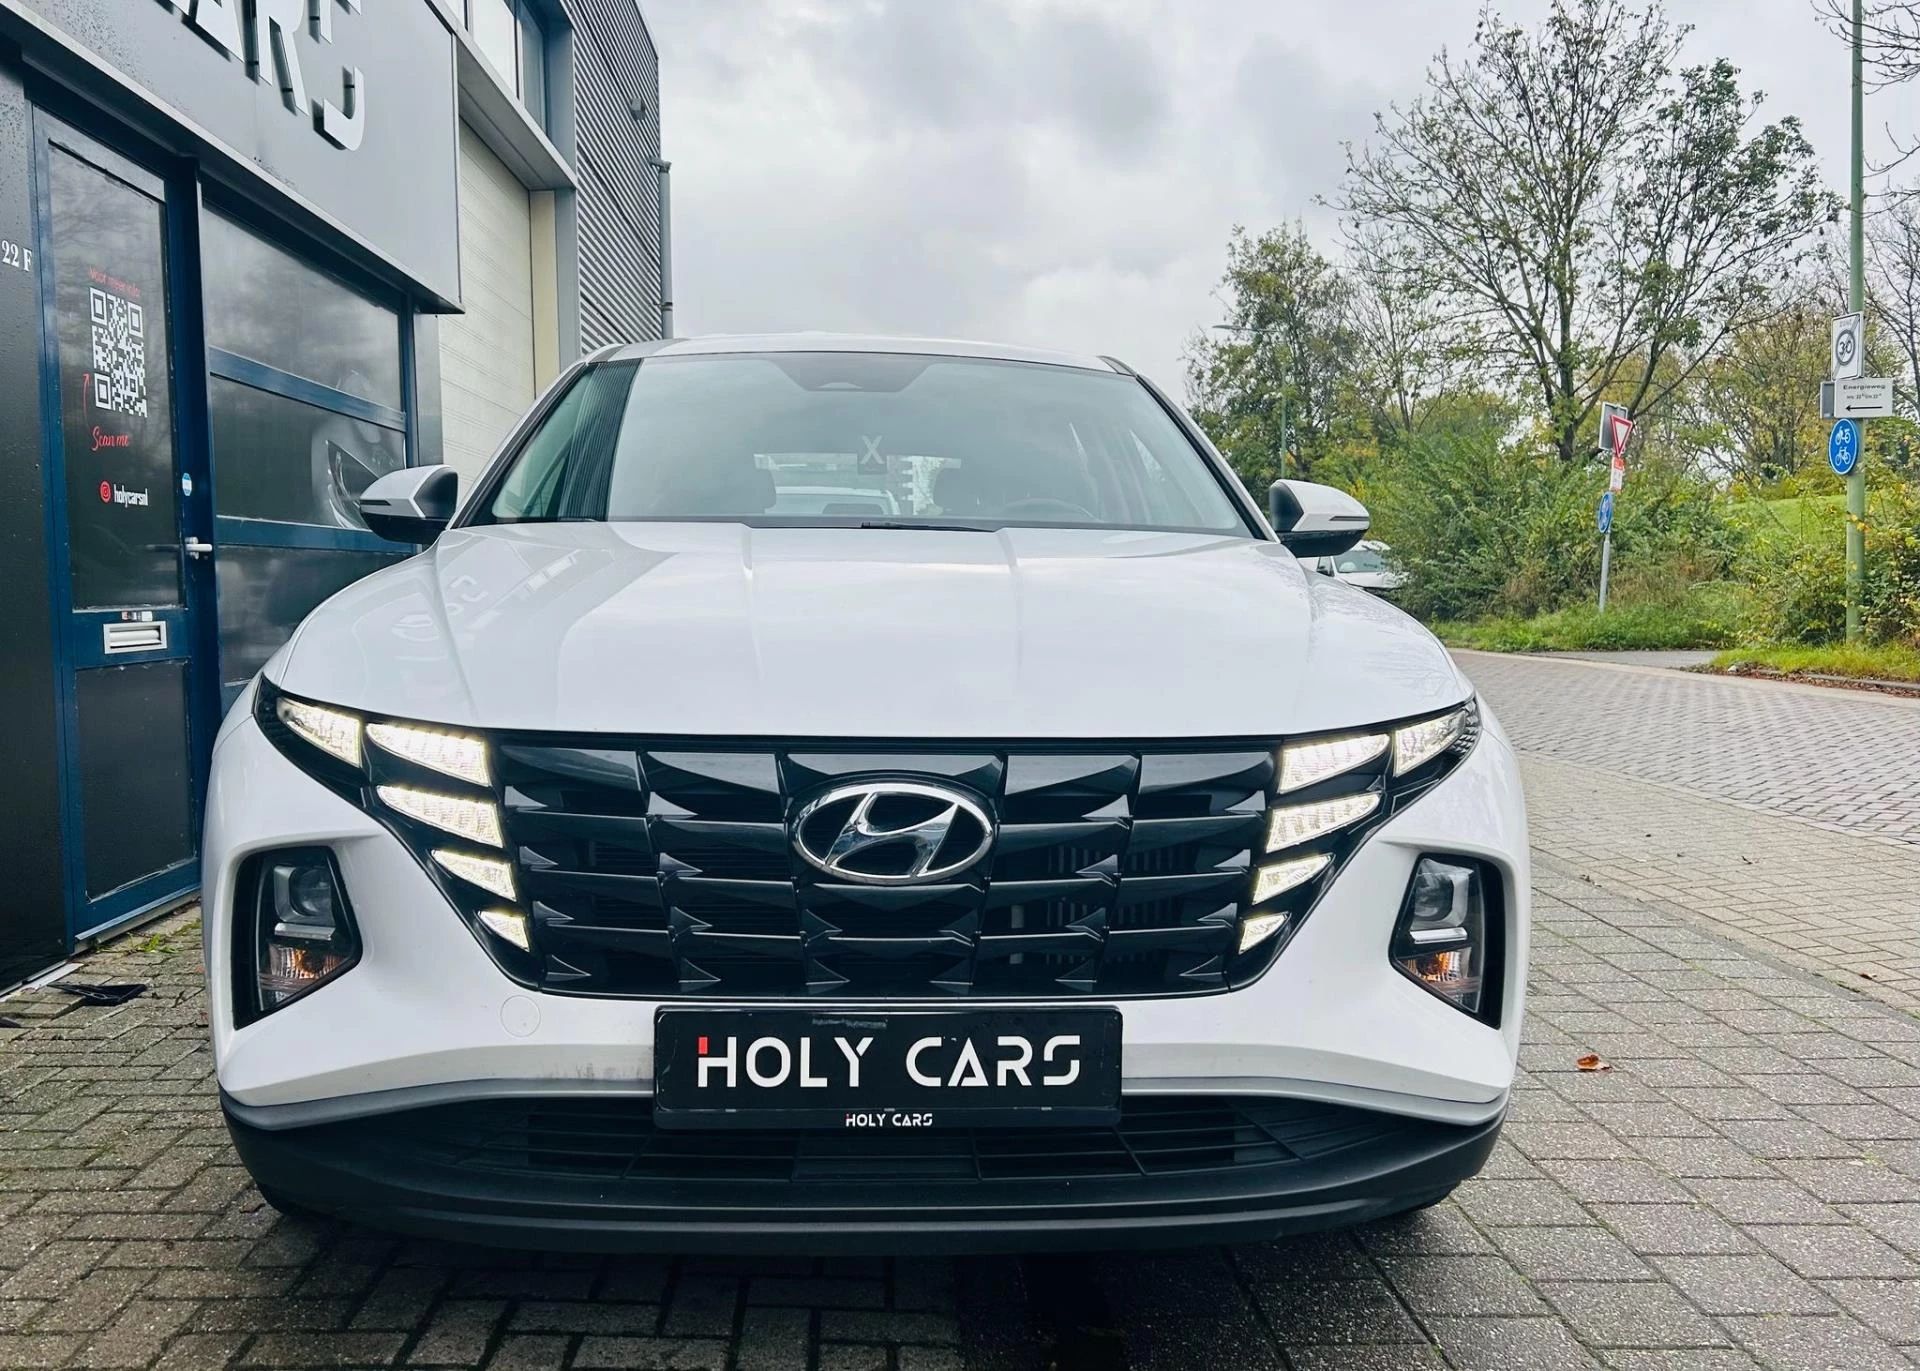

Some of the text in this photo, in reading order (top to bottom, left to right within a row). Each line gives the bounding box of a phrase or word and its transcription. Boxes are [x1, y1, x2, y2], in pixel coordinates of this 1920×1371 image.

[1, 240, 33, 272] 22 F
[1839, 340, 1853, 356] 30
[92, 426, 115, 451] Scan
[113, 483, 149, 508] holycarsnl
[697, 1035, 1081, 1088] HOLY CARS
[845, 1112, 934, 1127] HOLY CARS
